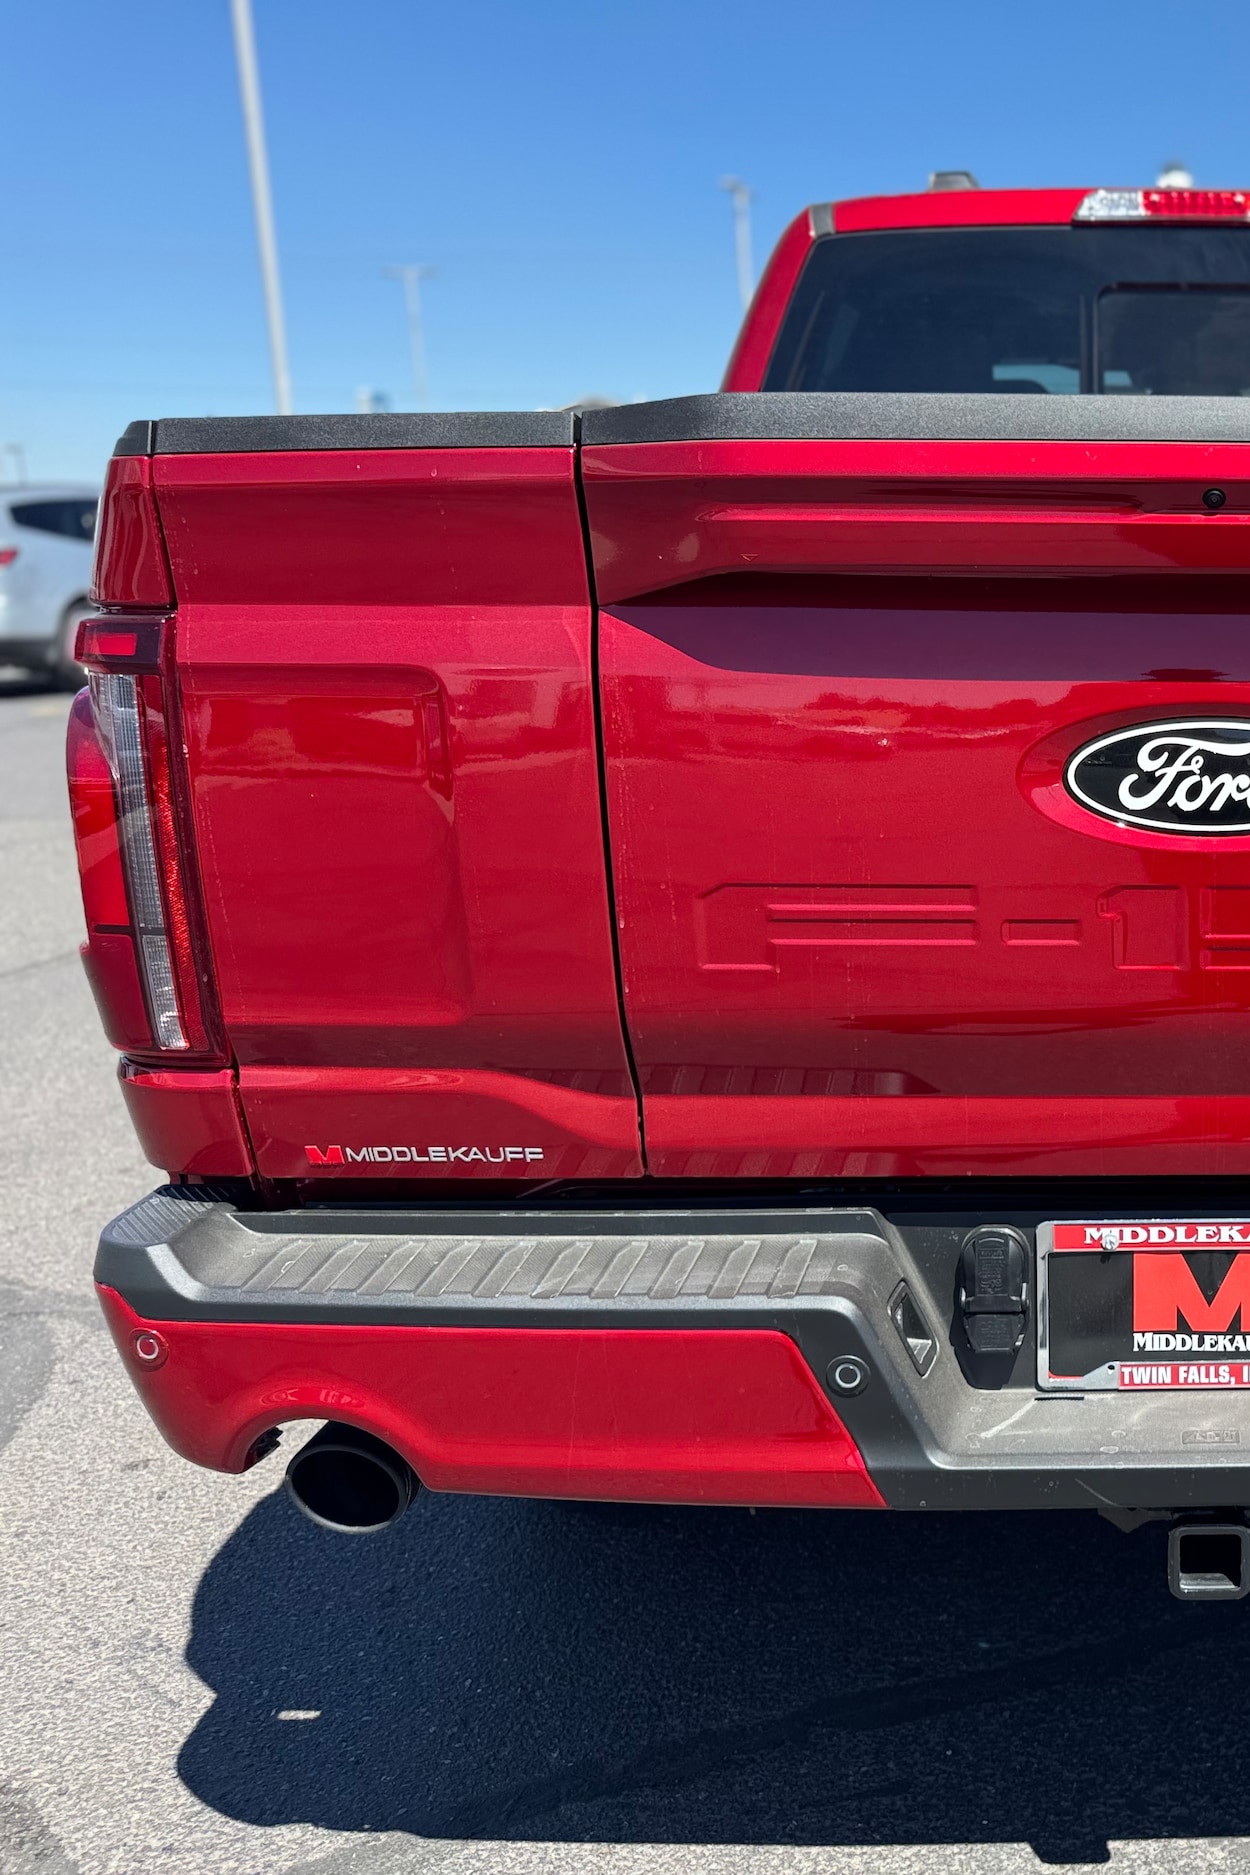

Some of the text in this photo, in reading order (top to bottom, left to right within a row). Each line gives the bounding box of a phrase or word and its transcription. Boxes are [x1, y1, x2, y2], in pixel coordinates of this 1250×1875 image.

[345, 1146, 545, 1163] MIDDLEKAUFF
[1121, 1366, 1169, 1385] TWIN
[1178, 1365, 1236, 1386] FALLS,
